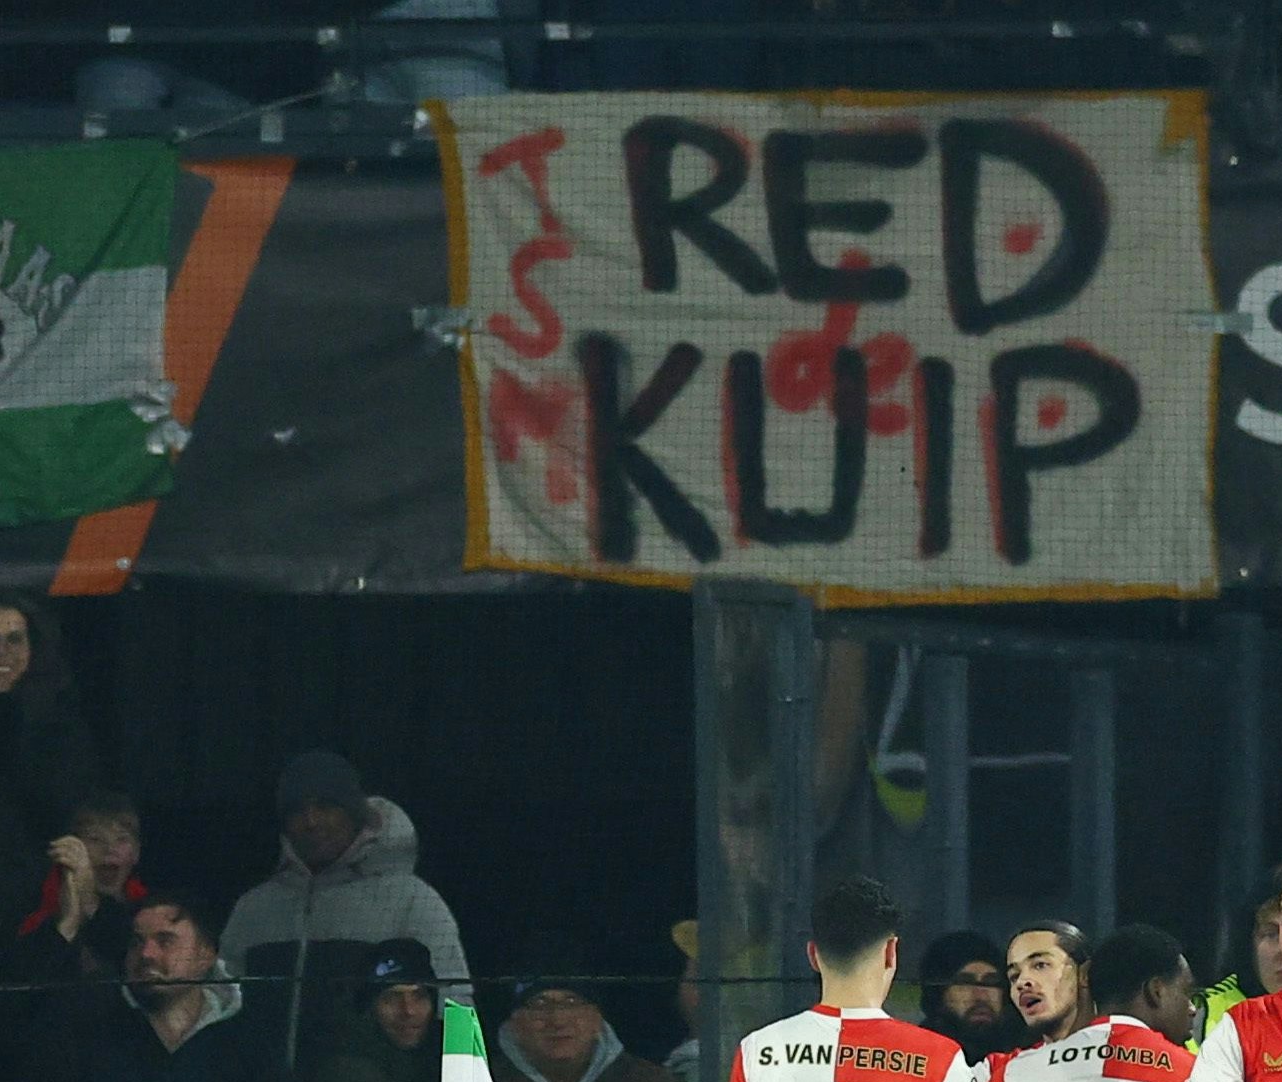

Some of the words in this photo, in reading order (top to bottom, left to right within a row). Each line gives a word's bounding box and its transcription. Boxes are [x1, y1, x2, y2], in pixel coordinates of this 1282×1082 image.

[622, 113, 1111, 335] RED
[574, 329, 1141, 566] KUIP
[758, 1046, 780, 1066] S.
[785, 1044, 832, 1064] VAN
[838, 1046, 927, 1077] PERSIE
[1048, 1044, 1173, 1071] LOTOMBA
